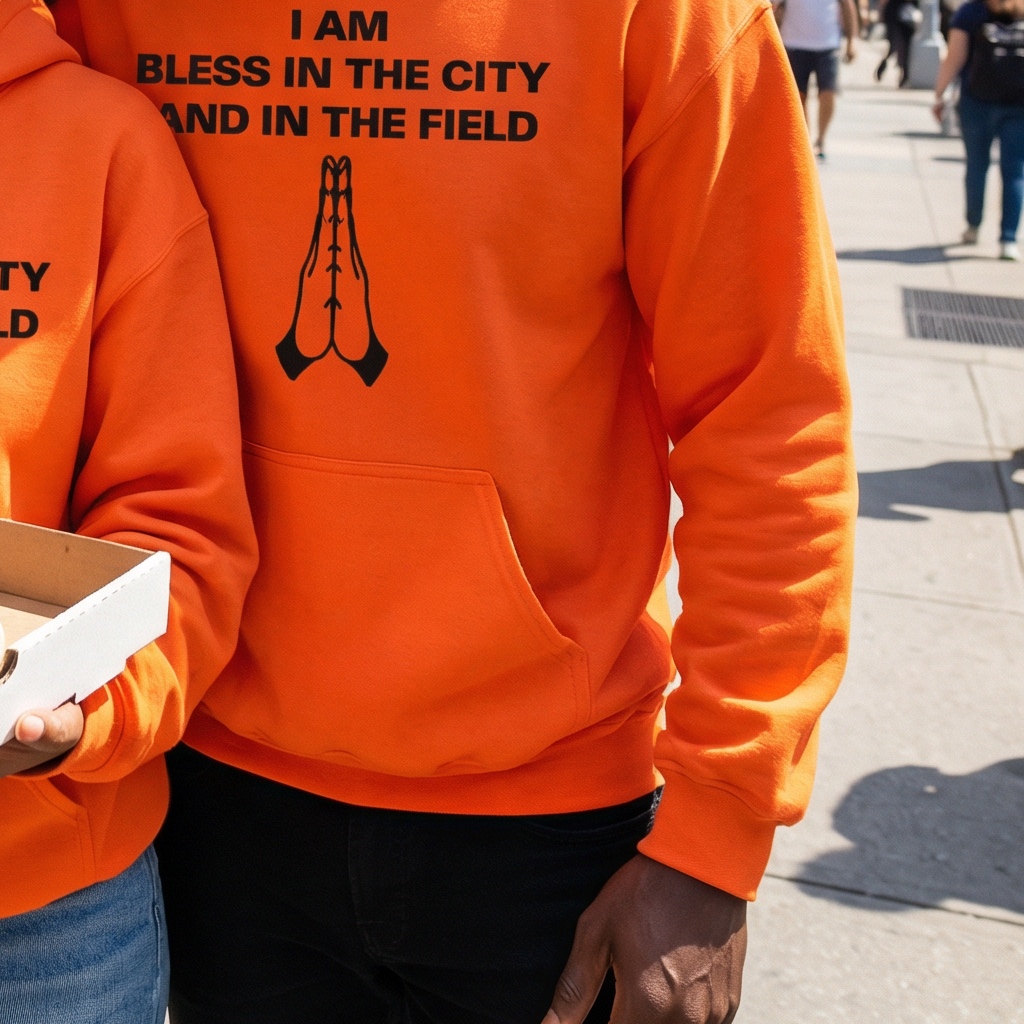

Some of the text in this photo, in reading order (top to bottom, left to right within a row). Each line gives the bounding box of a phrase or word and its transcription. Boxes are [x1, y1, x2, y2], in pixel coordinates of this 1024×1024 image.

[291, 9, 388, 41] I AM
[136, 53, 551, 93] BLESS IN THE CITY
[160, 103, 538, 142] AND IN THE FIELD
